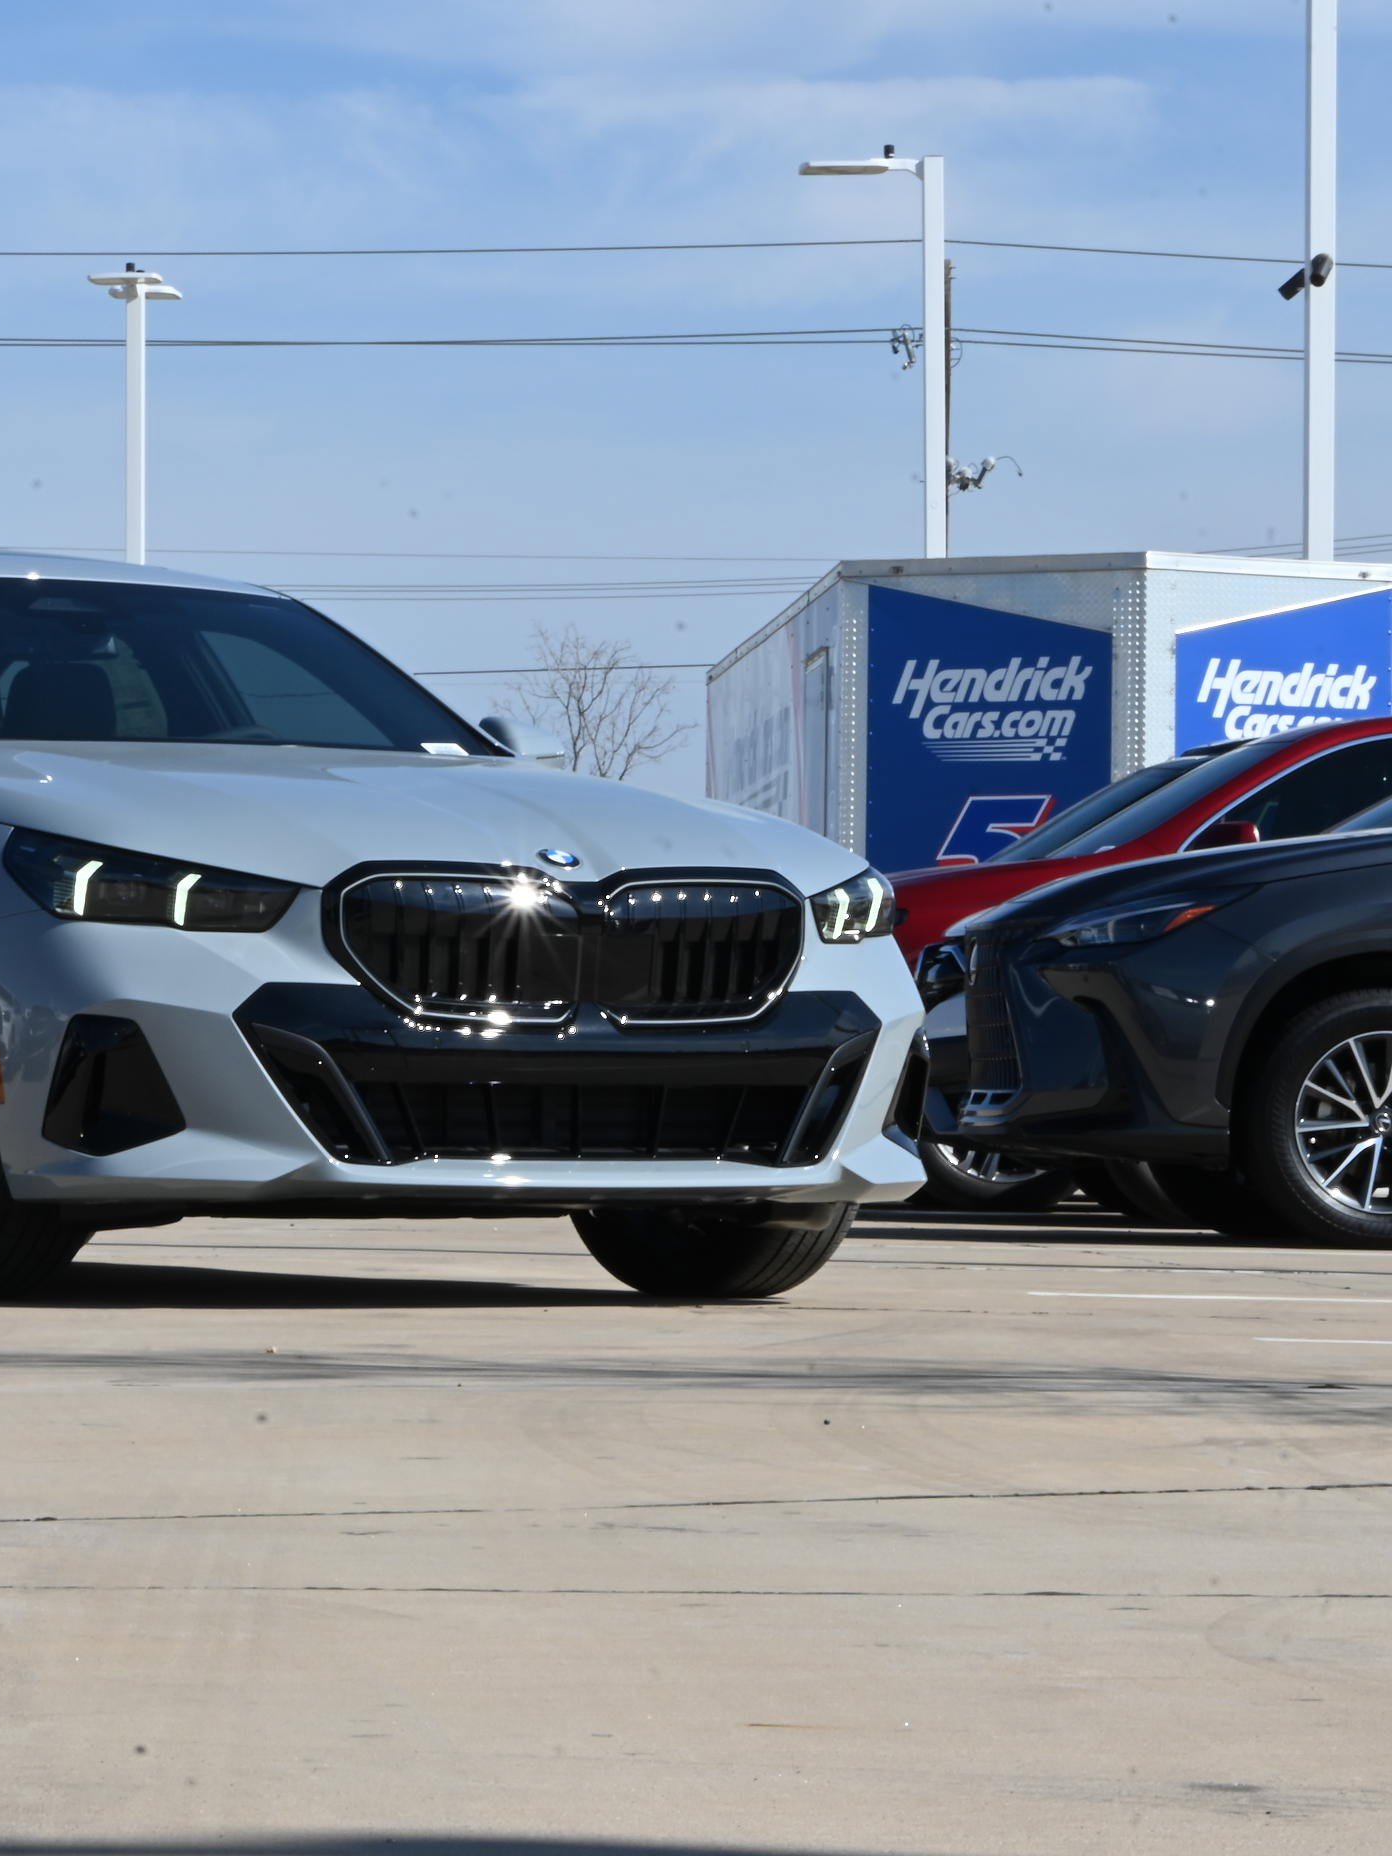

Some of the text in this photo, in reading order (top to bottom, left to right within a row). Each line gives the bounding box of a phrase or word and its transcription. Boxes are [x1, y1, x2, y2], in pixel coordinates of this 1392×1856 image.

[892, 656, 1093, 719] Hendrick
[1197, 657, 1377, 718] Hendrick
[922, 705, 1076, 739] Cars.com
